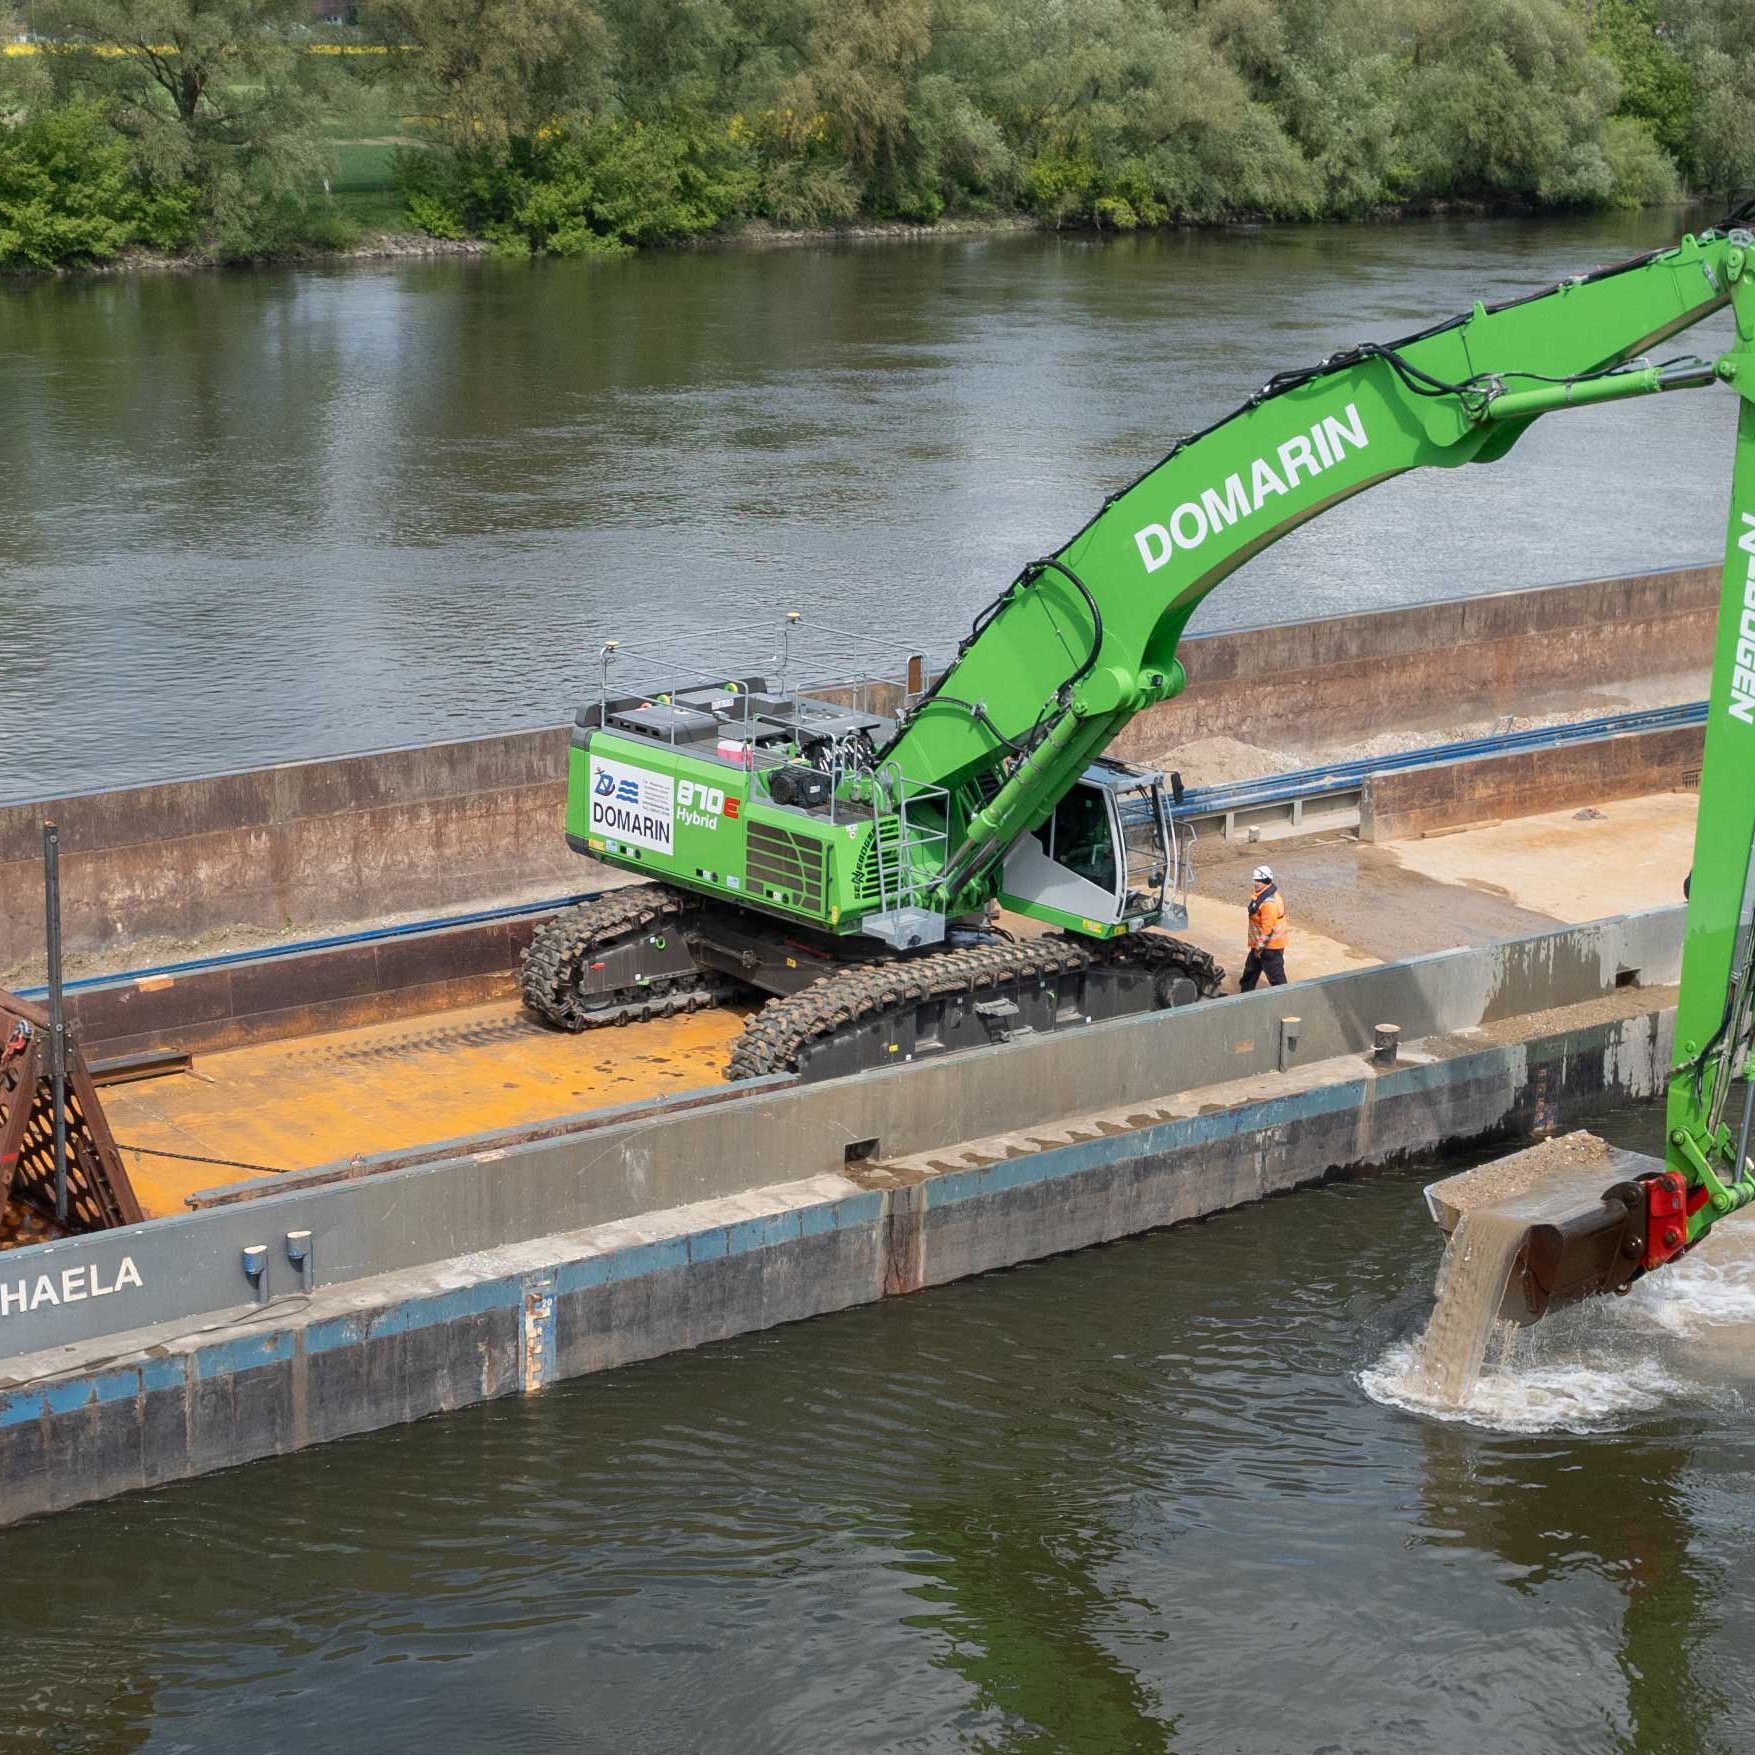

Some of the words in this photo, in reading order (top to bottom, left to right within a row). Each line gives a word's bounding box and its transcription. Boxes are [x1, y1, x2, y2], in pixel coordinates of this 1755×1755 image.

[1133, 403, 1369, 574] DOMARIN
[593, 802, 670, 844] DOMARIN
[676, 807, 718, 831] Hybrid
